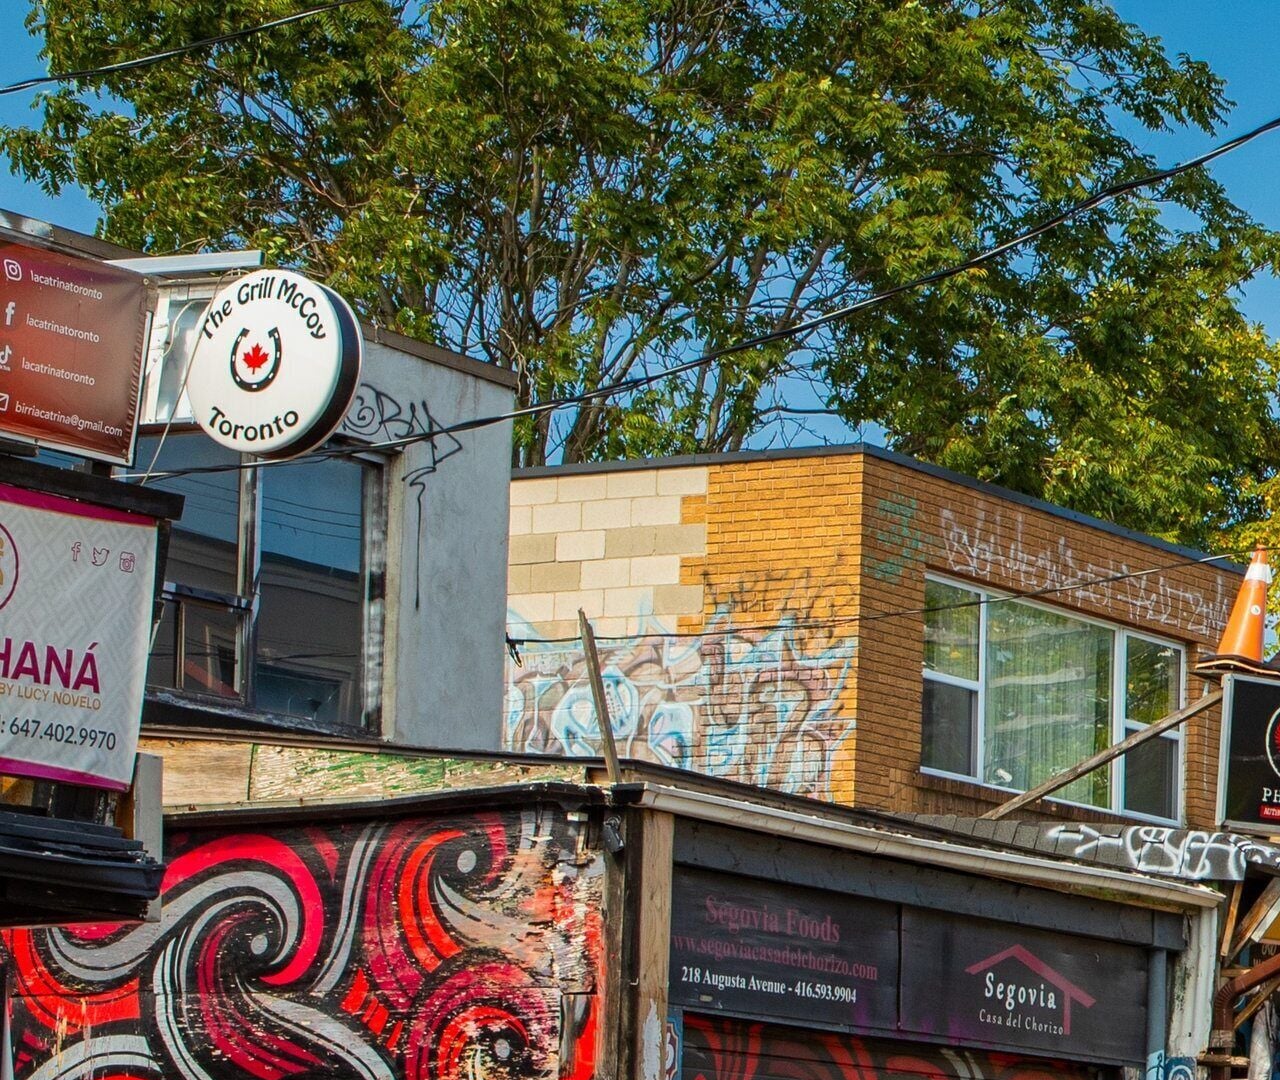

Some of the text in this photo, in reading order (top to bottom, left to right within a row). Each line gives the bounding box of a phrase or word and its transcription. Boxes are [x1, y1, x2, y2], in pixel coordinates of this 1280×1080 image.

[30, 270, 103, 300] lacatrinatoronto
[201, 276, 326, 340] The Grill McCoy
[26, 313, 100, 343] lacatrinatoronto
[22, 357, 95, 386] lacatrinatoronto
[15, 401, 123, 437] birriacatrina@gmail.com
[207, 406, 299, 441] Toronto
[17, 686, 50, 702] LUCY
[52, 691, 101, 710] NOVELO
[10, 717, 116, 750] 647.402.9970
[705, 895, 841, 943] Segovia Foods
[682, 966, 700, 983] 218
[702, 969, 745, 990] Augusta
[748, 975, 786, 994] Avenue
[795, 981, 857, 1003] 416.593.9904
[985, 972, 1057, 1010] Segovia
[979, 1008, 1064, 1035] Casa del Chorizo
